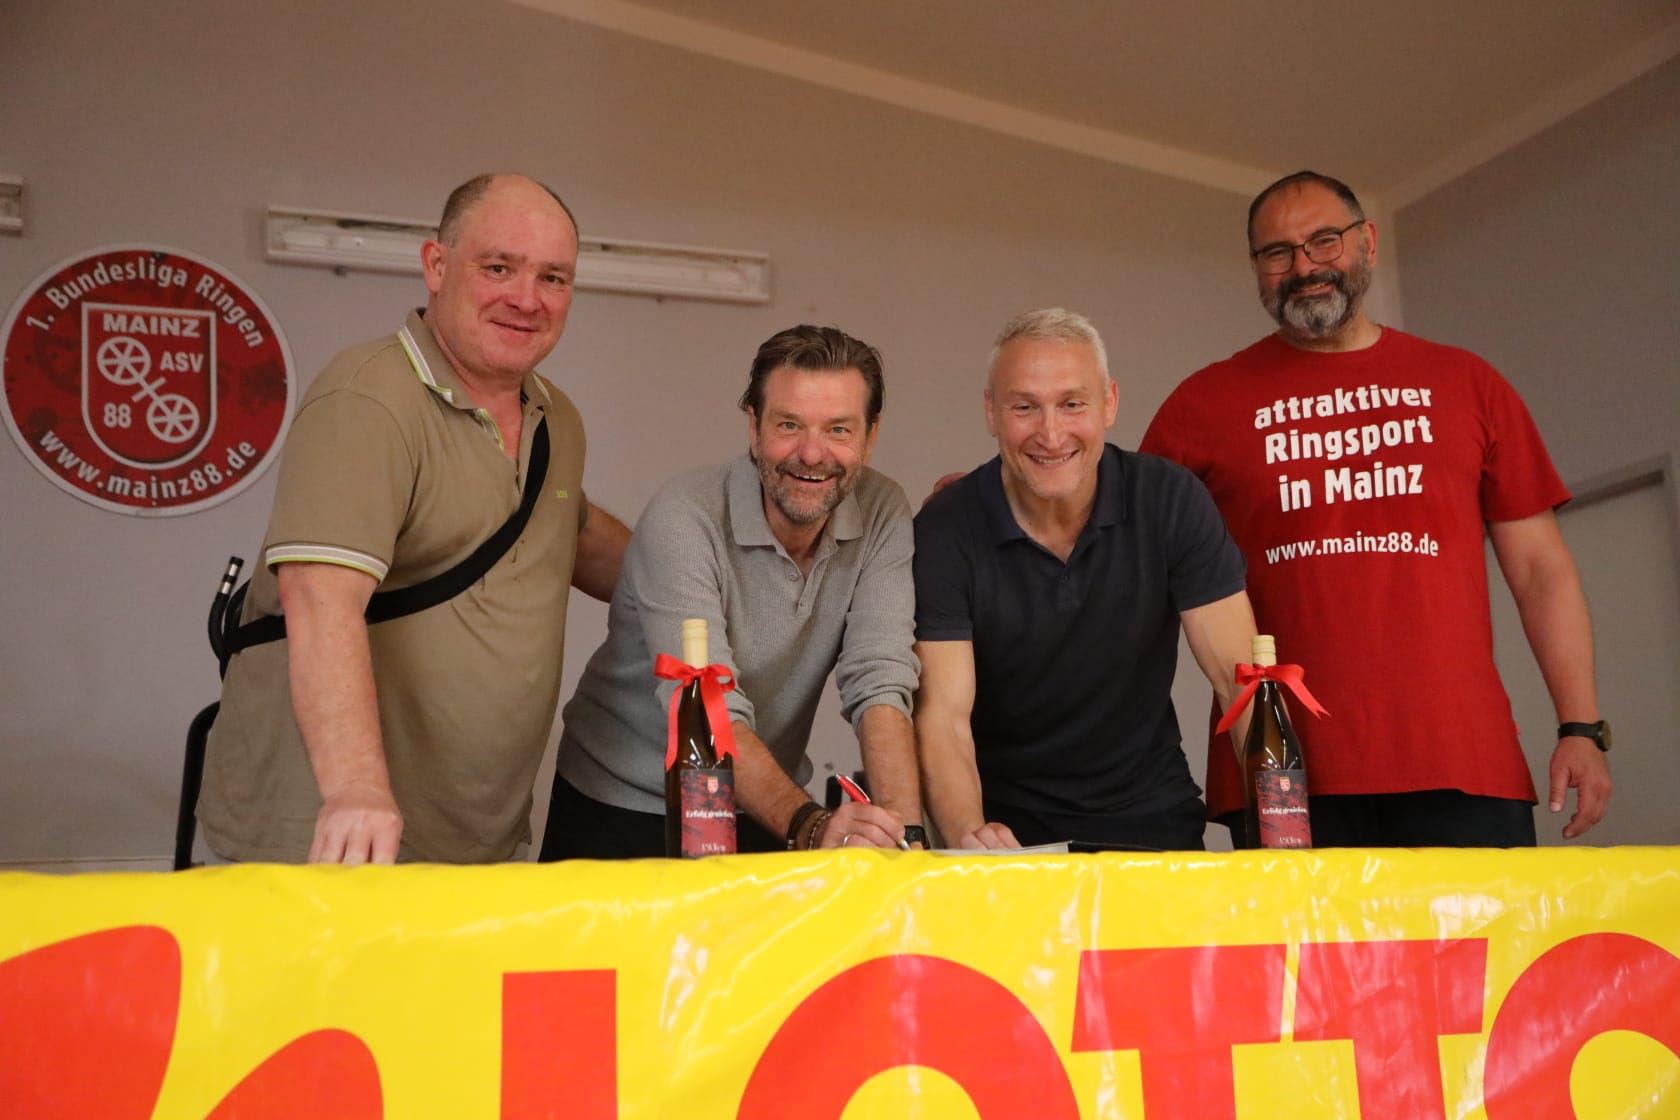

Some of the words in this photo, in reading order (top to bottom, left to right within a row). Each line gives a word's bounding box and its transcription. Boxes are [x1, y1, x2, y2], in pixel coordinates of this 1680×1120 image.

[26, 312, 55, 331] 1.
[45, 256, 189, 310] Bundesliga
[195, 274, 264, 348] Ringen
[103, 313, 201, 338] MAINZ
[160, 352, 204, 373] ASV
[103, 403, 132, 429] 88
[1254, 384, 1432, 430] attraktiver
[1265, 416, 1434, 465] Ringsport
[39, 430, 257, 499] www.mainz88.de
[1278, 475, 1312, 512] in
[1324, 461, 1424, 505] Mainz
[1266, 531, 1439, 565] www.mainz88.de
